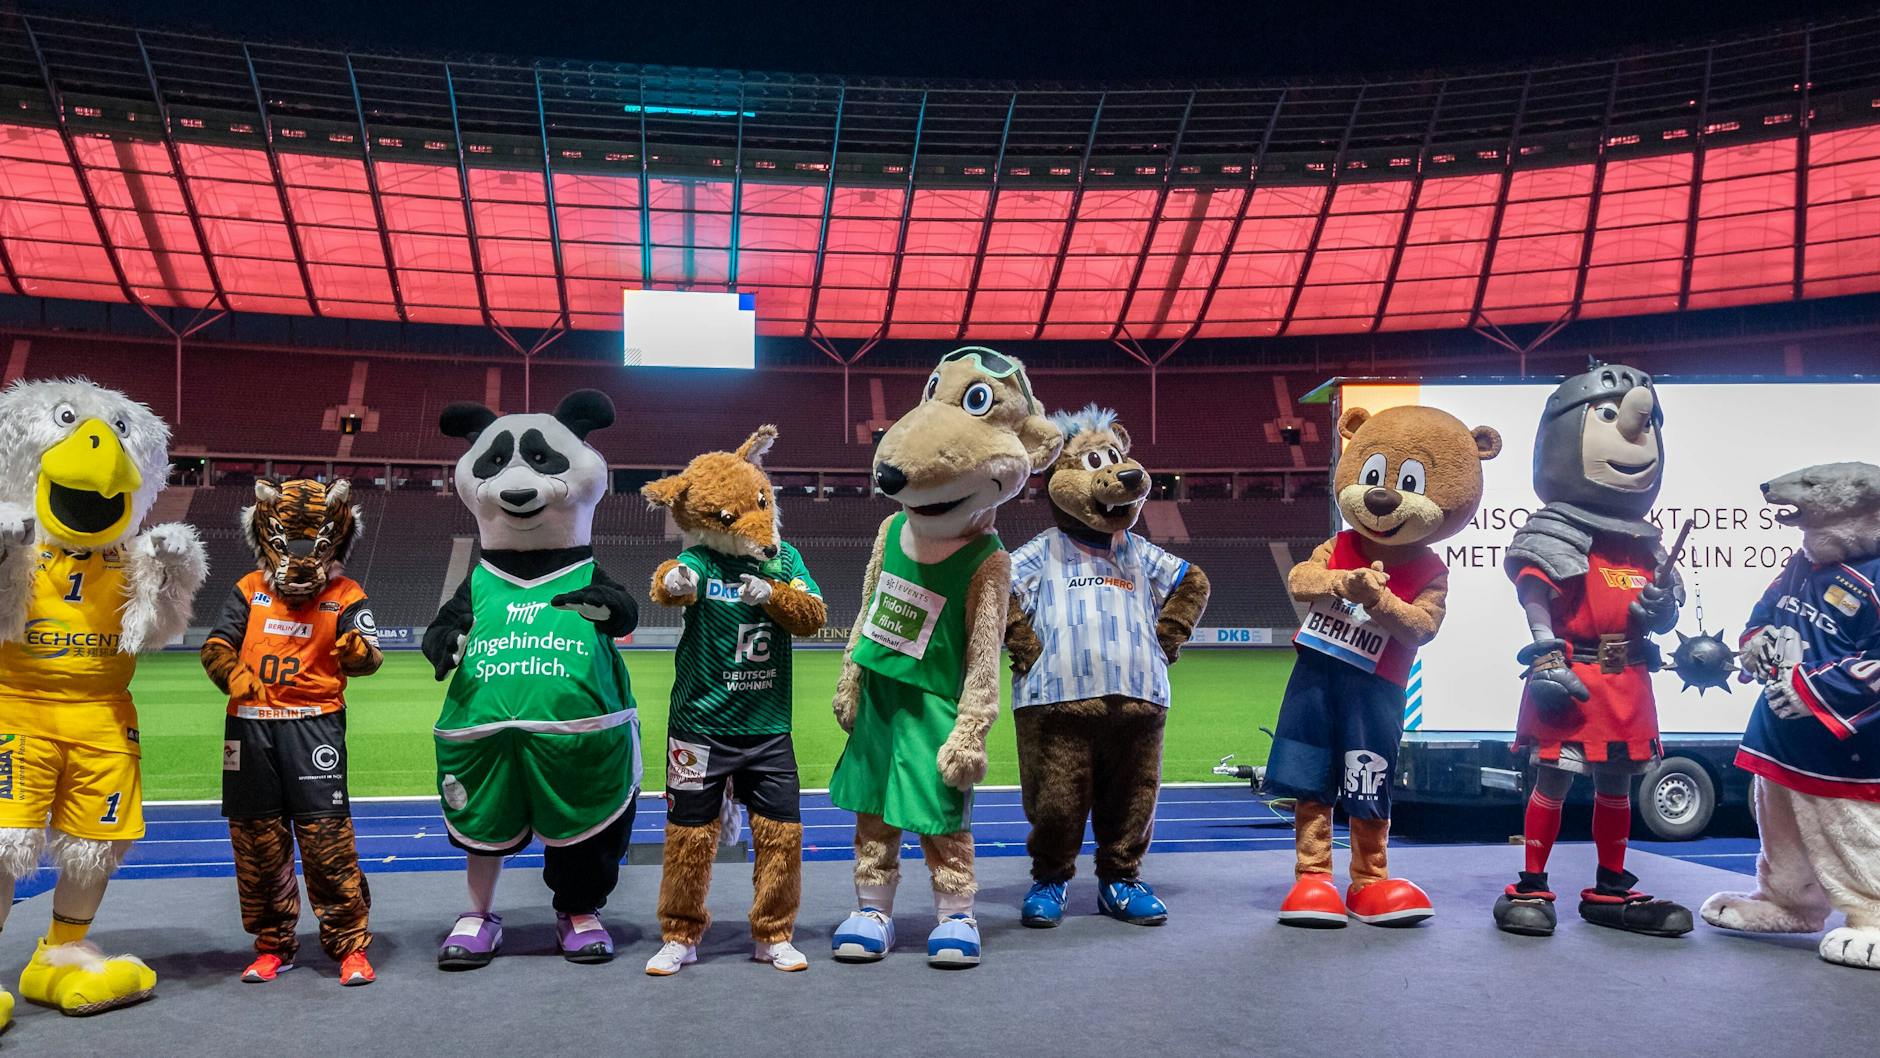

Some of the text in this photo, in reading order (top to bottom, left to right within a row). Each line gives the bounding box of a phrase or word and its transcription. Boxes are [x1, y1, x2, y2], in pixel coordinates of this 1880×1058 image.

[1650, 508, 1681, 530] KT
[1693, 508, 1748, 530] DER
[1447, 546, 1793, 567] MET RLIN 202
[64, 572, 84, 602] 1
[709, 583, 740, 599] DKB
[1069, 577, 1134, 591] AUTOHERO
[898, 585, 929, 602] EVENTS
[267, 623, 294, 632] BERLIN
[1217, 629, 1250, 641] DKB
[1307, 611, 1383, 656] BERLINO
[25, 630, 120, 646] ECHCENT
[467, 631, 589, 657] Ungehindert.
[259, 654, 300, 687] 02
[475, 655, 571, 683] Sportlich.
[722, 668, 777, 681] DEUTSCHE
[726, 680, 773, 691] WOHNEN
[258, 708, 298, 719] BERLIN
[100, 792, 121, 824] 1
